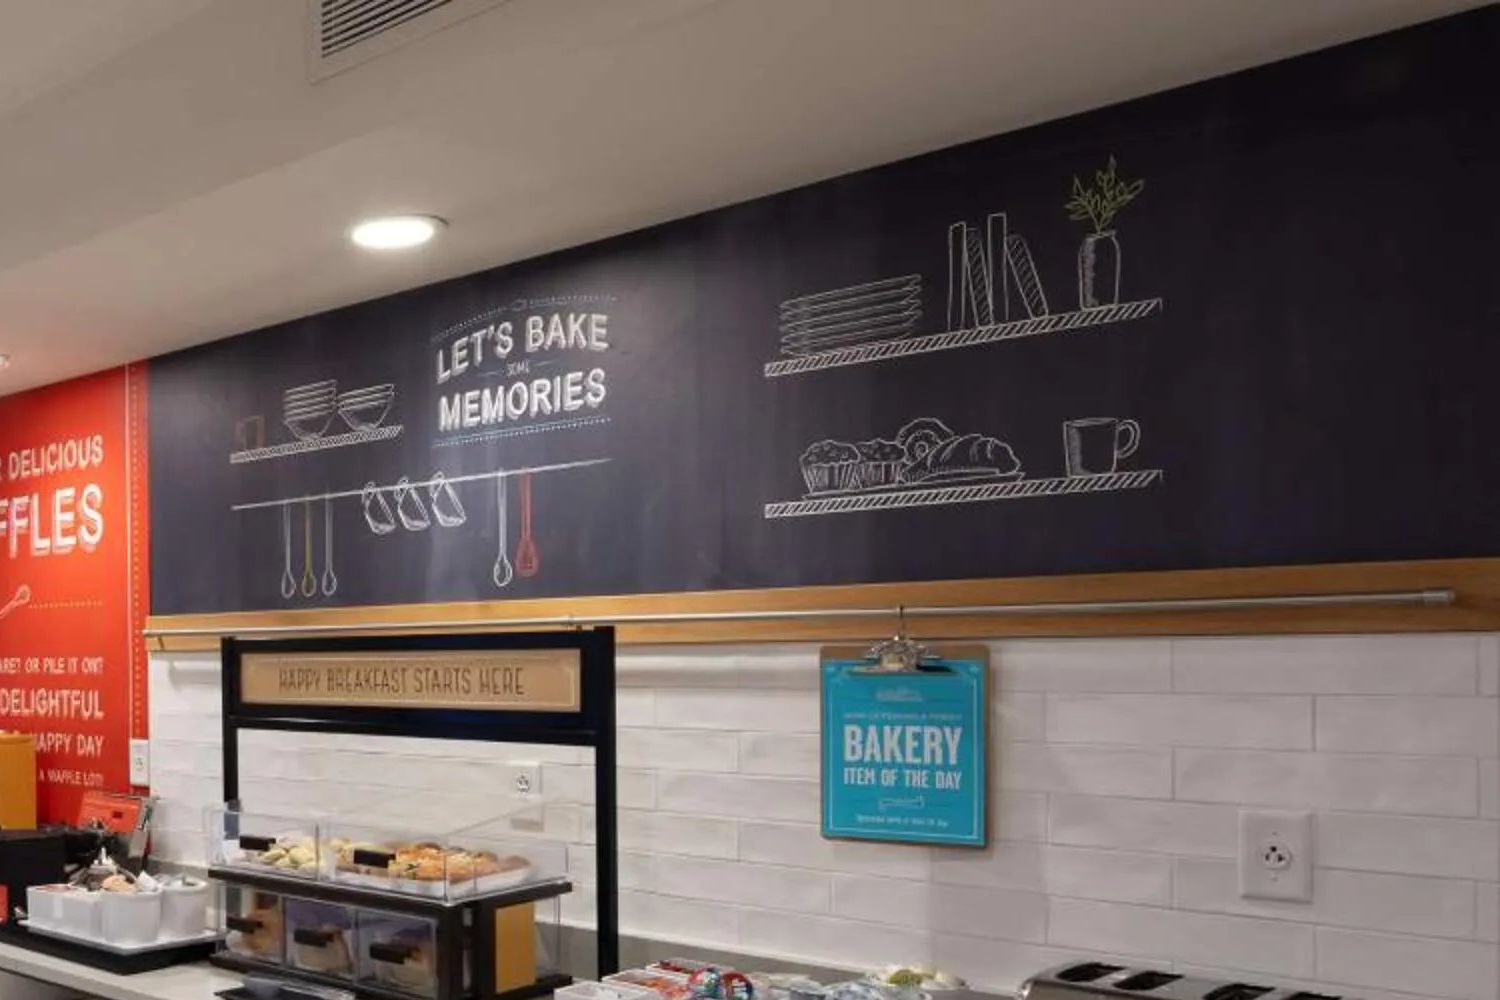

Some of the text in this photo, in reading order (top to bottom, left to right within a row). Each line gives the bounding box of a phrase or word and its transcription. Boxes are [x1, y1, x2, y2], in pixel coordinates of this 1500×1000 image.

[436, 312, 609, 385] LET'S BAKE
[438, 367, 607, 432] MEMORIES
[8, 434, 104, 482] DELICIOUS
[25, 656, 40, 674] OR
[43, 656, 66, 674] PILE
[68, 656, 78, 674] IT
[279, 667, 525, 695] HAPPY BREAKFAST STARTS HERE
[0, 687, 105, 719] DELIGHTFUL
[31, 731, 104, 758] APPY DAY
[843, 723, 963, 765] BAKERY
[47, 769, 82, 786] WAFFLE
[843, 766, 962, 790] ITEM OF THE DAY
